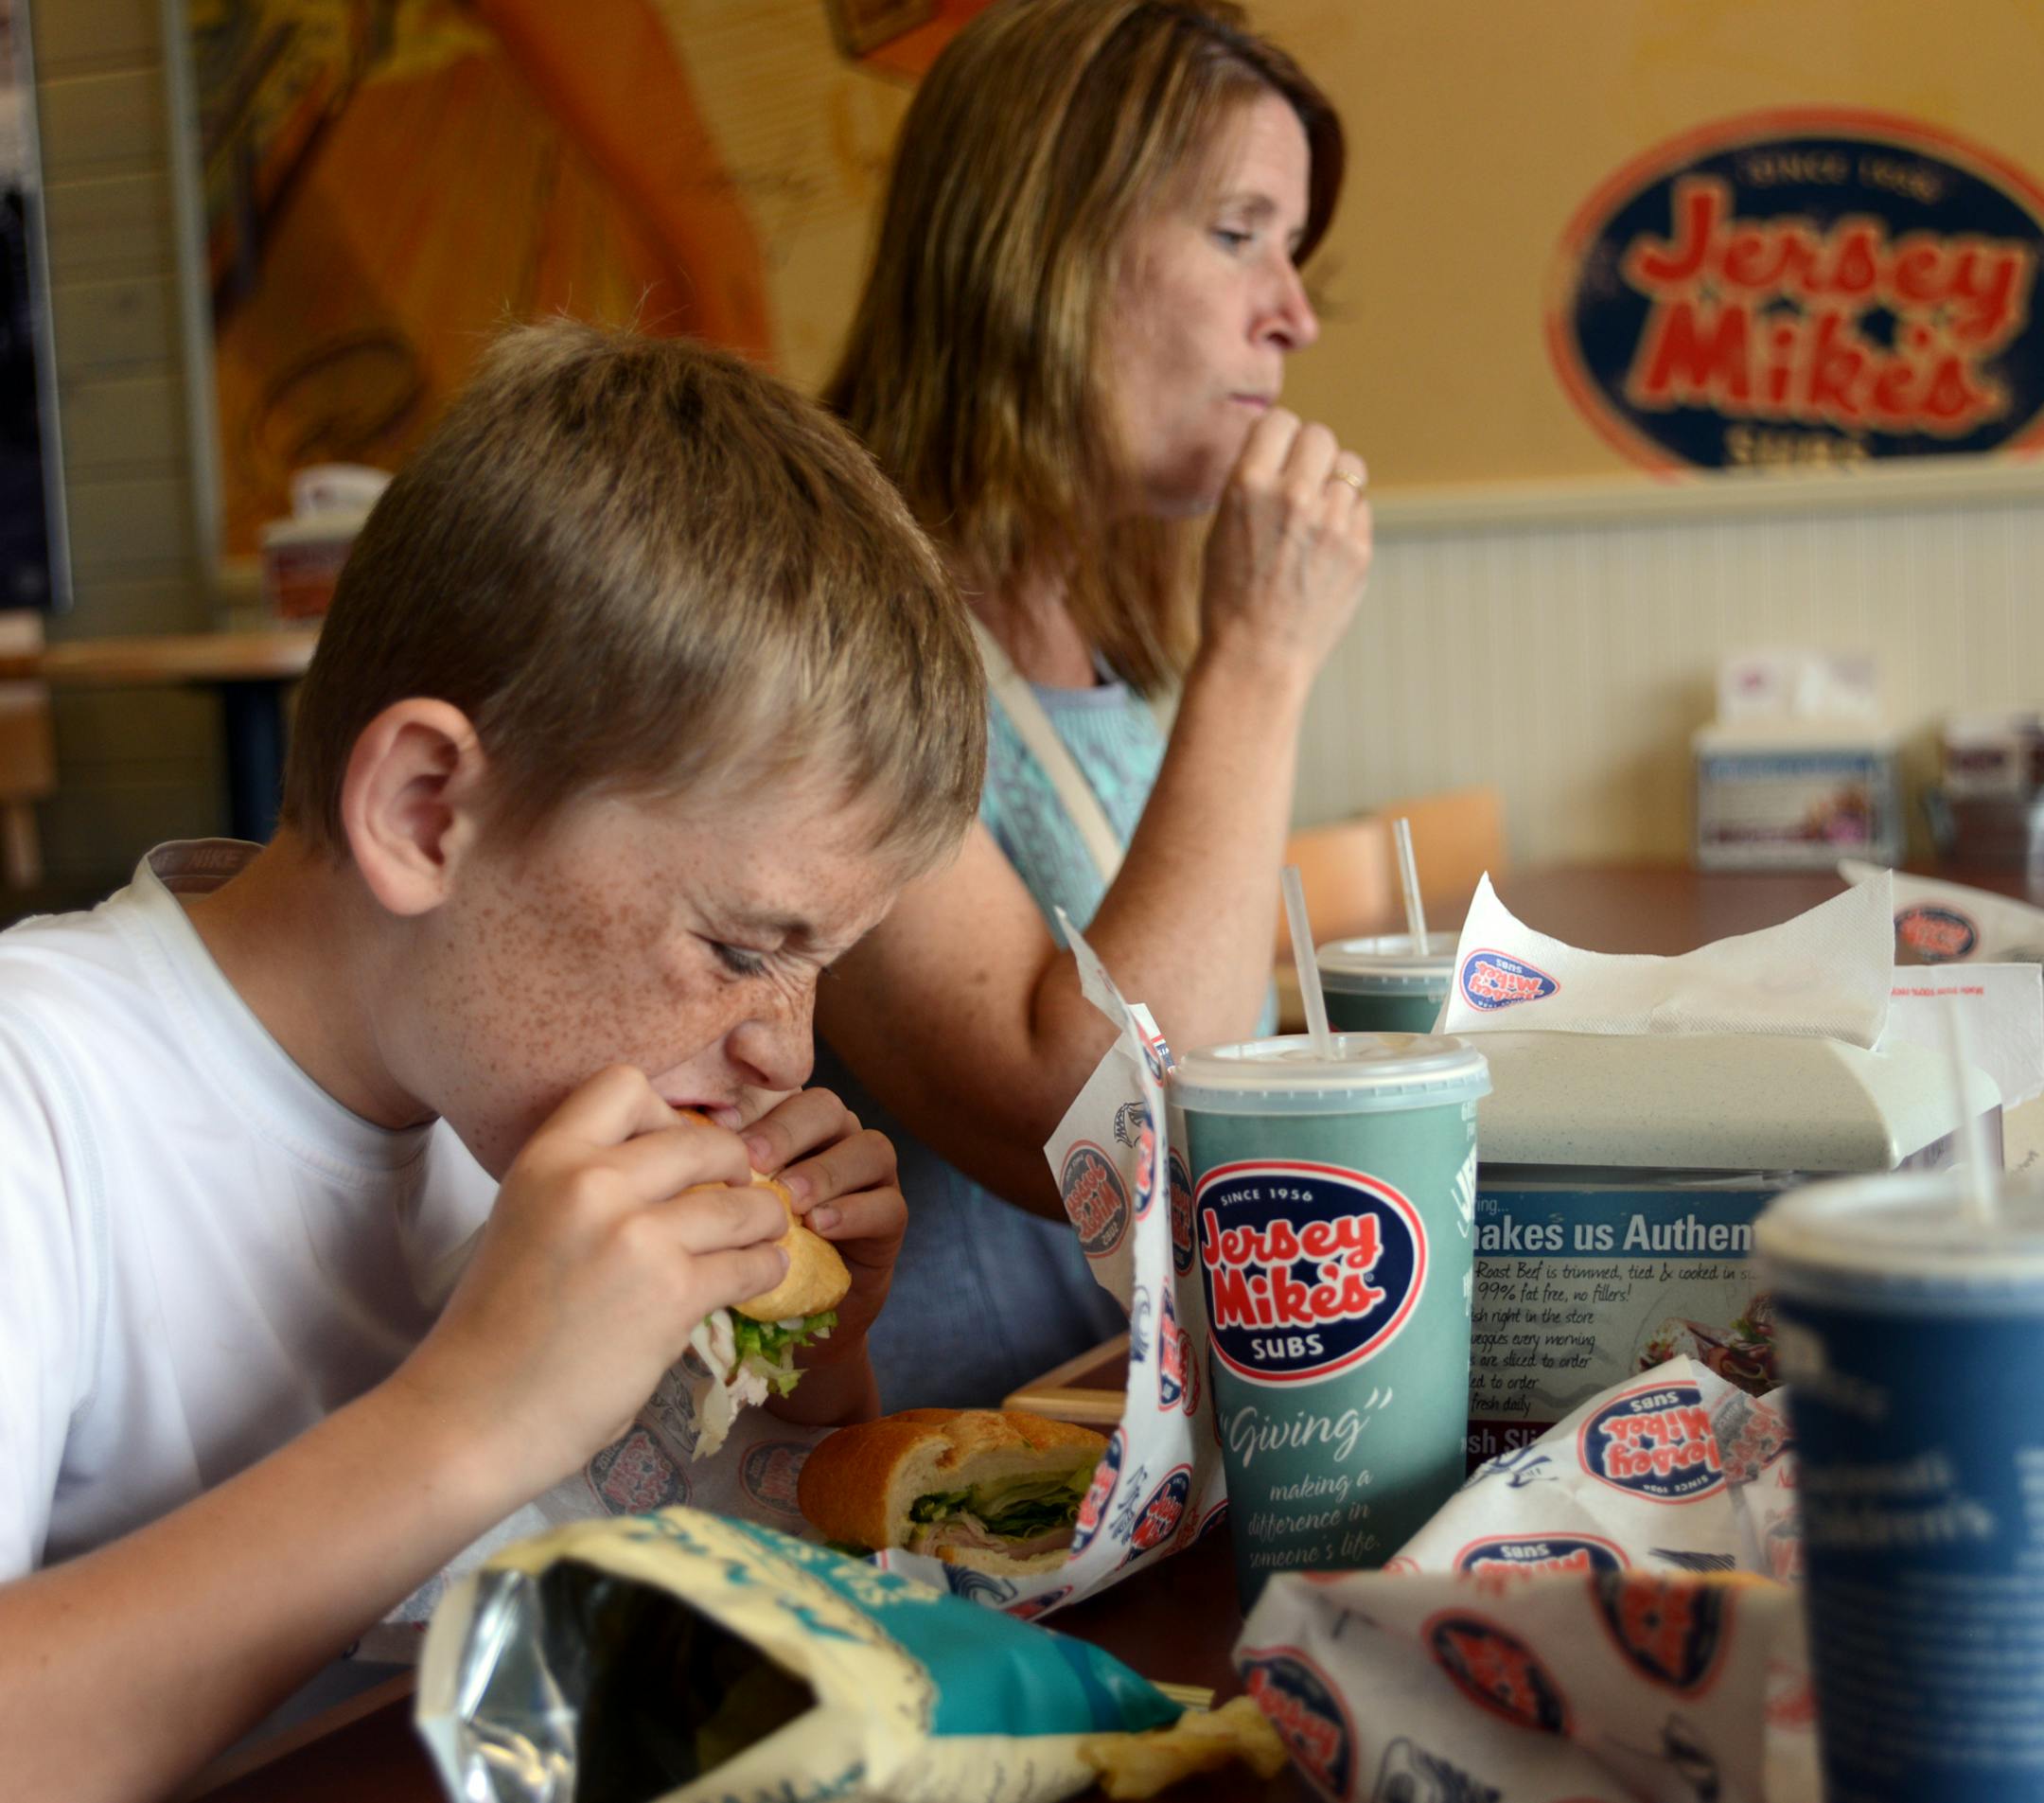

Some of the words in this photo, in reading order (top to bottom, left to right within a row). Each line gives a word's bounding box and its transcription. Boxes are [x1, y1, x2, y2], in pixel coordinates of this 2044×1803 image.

[1631, 180, 2026, 345] Jersey
[1221, 1187, 1260, 1207] SINCE
[1270, 1187, 1313, 1202] 1956
[1201, 1208, 1383, 1269] Jersey
[1574, 1225, 1613, 1251] us
[1475, 1261, 1510, 1279] Roast
[1517, 1260, 1543, 1281] Beef
[1546, 1265, 1557, 1279] is
[1562, 1264, 1623, 1281] trimmed,
[1628, 1264, 1654, 1279] tied
[1660, 1262, 1674, 1282] &
[1679, 1262, 1718, 1280] cooked
[1723, 1266, 1735, 1279] in
[1210, 1262, 1385, 1329] Mike's
[1477, 1282, 1516, 1301] 99%
[1520, 1282, 1538, 1302] fat
[1542, 1282, 1568, 1303] free,
[1574, 1290, 1588, 1301] no
[1593, 1283, 1631, 1303] fillers!
[1491, 1310, 1521, 1331] right
[1525, 1310, 1537, 1323] in
[1542, 1309, 1560, 1324] the
[1565, 1310, 1594, 1324] store
[1251, 1334, 1324, 1360] SUBS
[1512, 1334, 1541, 1352] every
[1544, 1332, 1596, 1354] morning
[1480, 1355, 1497, 1368] are
[1504, 1350, 1537, 1368] sliced
[1542, 1352, 1555, 1369] to
[1559, 1353, 1592, 1369] order
[1490, 1373, 1503, 1389] to
[1507, 1373, 1540, 1389] order
[1471, 1392, 1500, 1413] fresh
[1503, 1394, 1531, 1419] daily
[1630, 1391, 1680, 1413] SUBS
[1270, 1473, 1351, 1503] making
[1356, 1469, 1372, 1487] a
[1674, 1474, 1709, 1494] SINCE
[1248, 1509, 1341, 1543] difference
[1348, 1500, 1371, 1519] in
[1249, 1534, 1333, 1569] someone's
[1340, 1529, 1381, 1558] life.
[1501, 1543, 1551, 1559] SUBS
